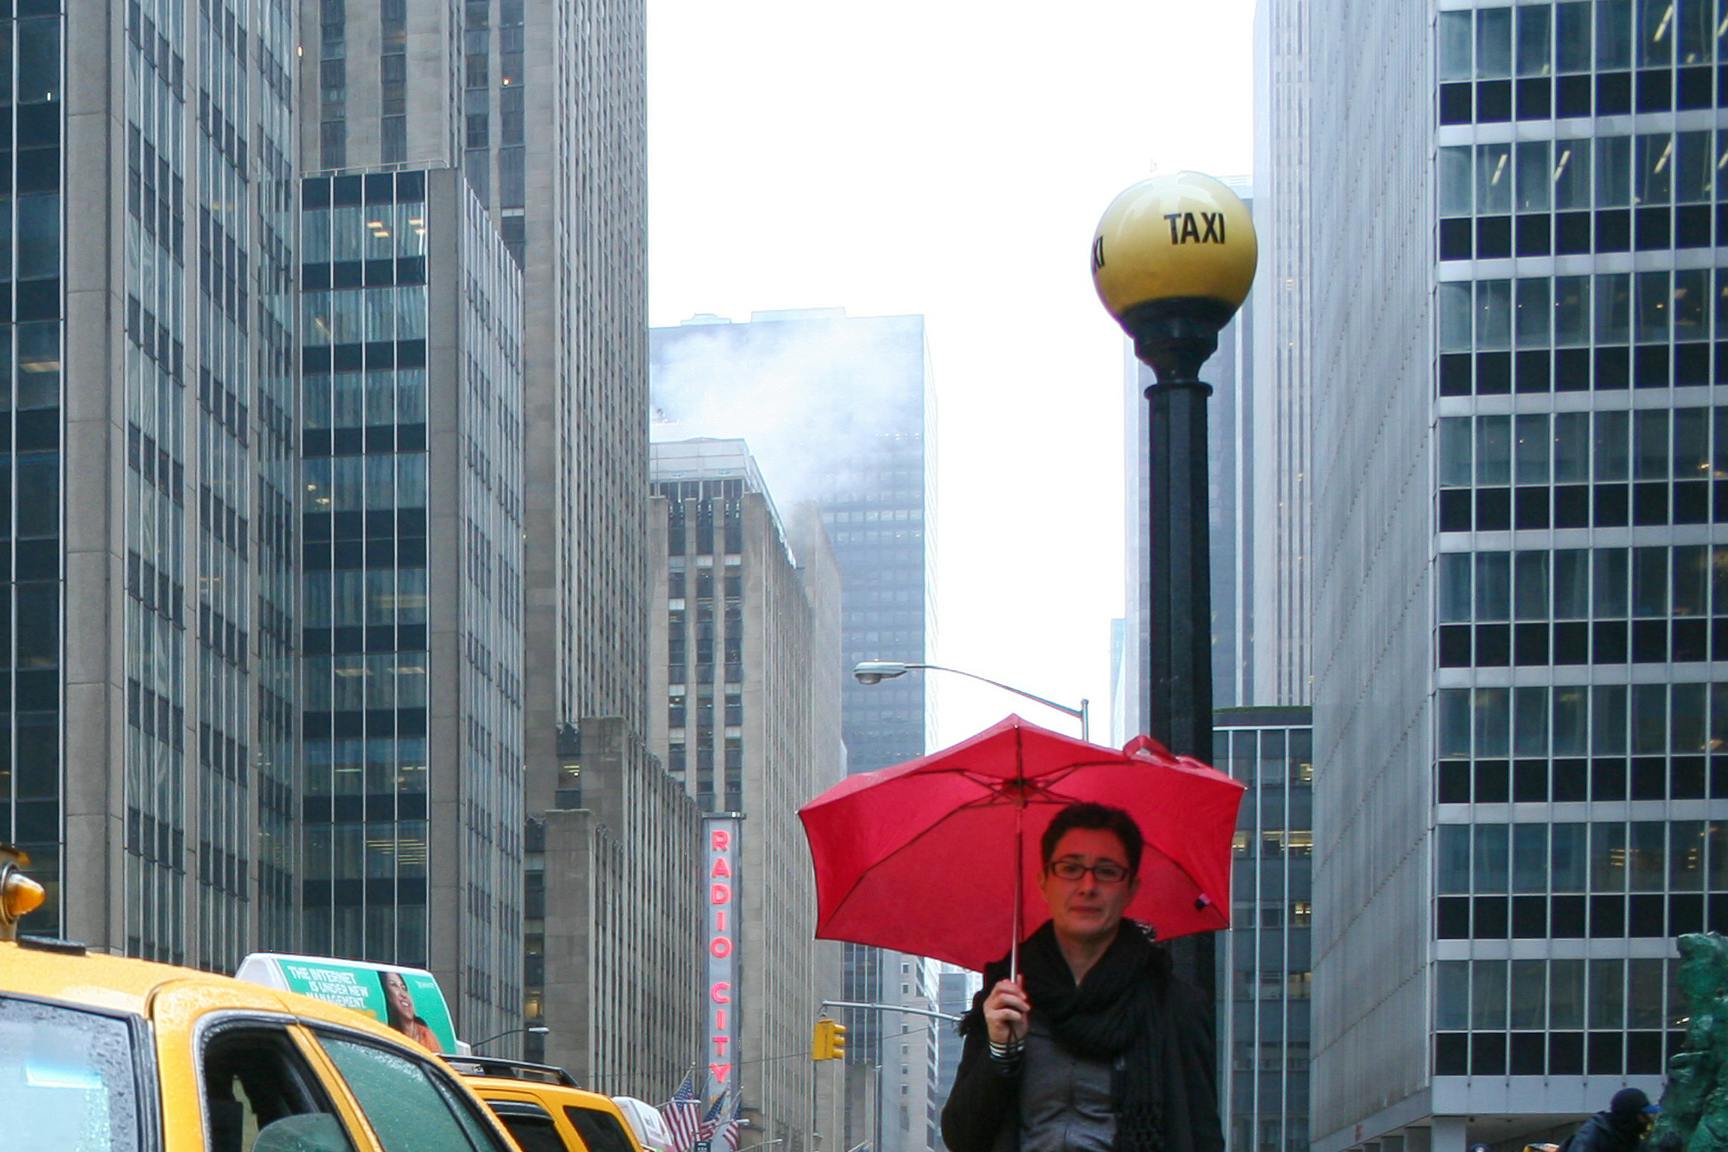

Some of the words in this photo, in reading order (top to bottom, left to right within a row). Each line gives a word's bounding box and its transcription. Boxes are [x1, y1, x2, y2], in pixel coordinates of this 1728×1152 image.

[1164, 212, 1225, 245] TAXI
[709, 831, 733, 959] RADIO
[709, 982, 733, 1084] CITY
